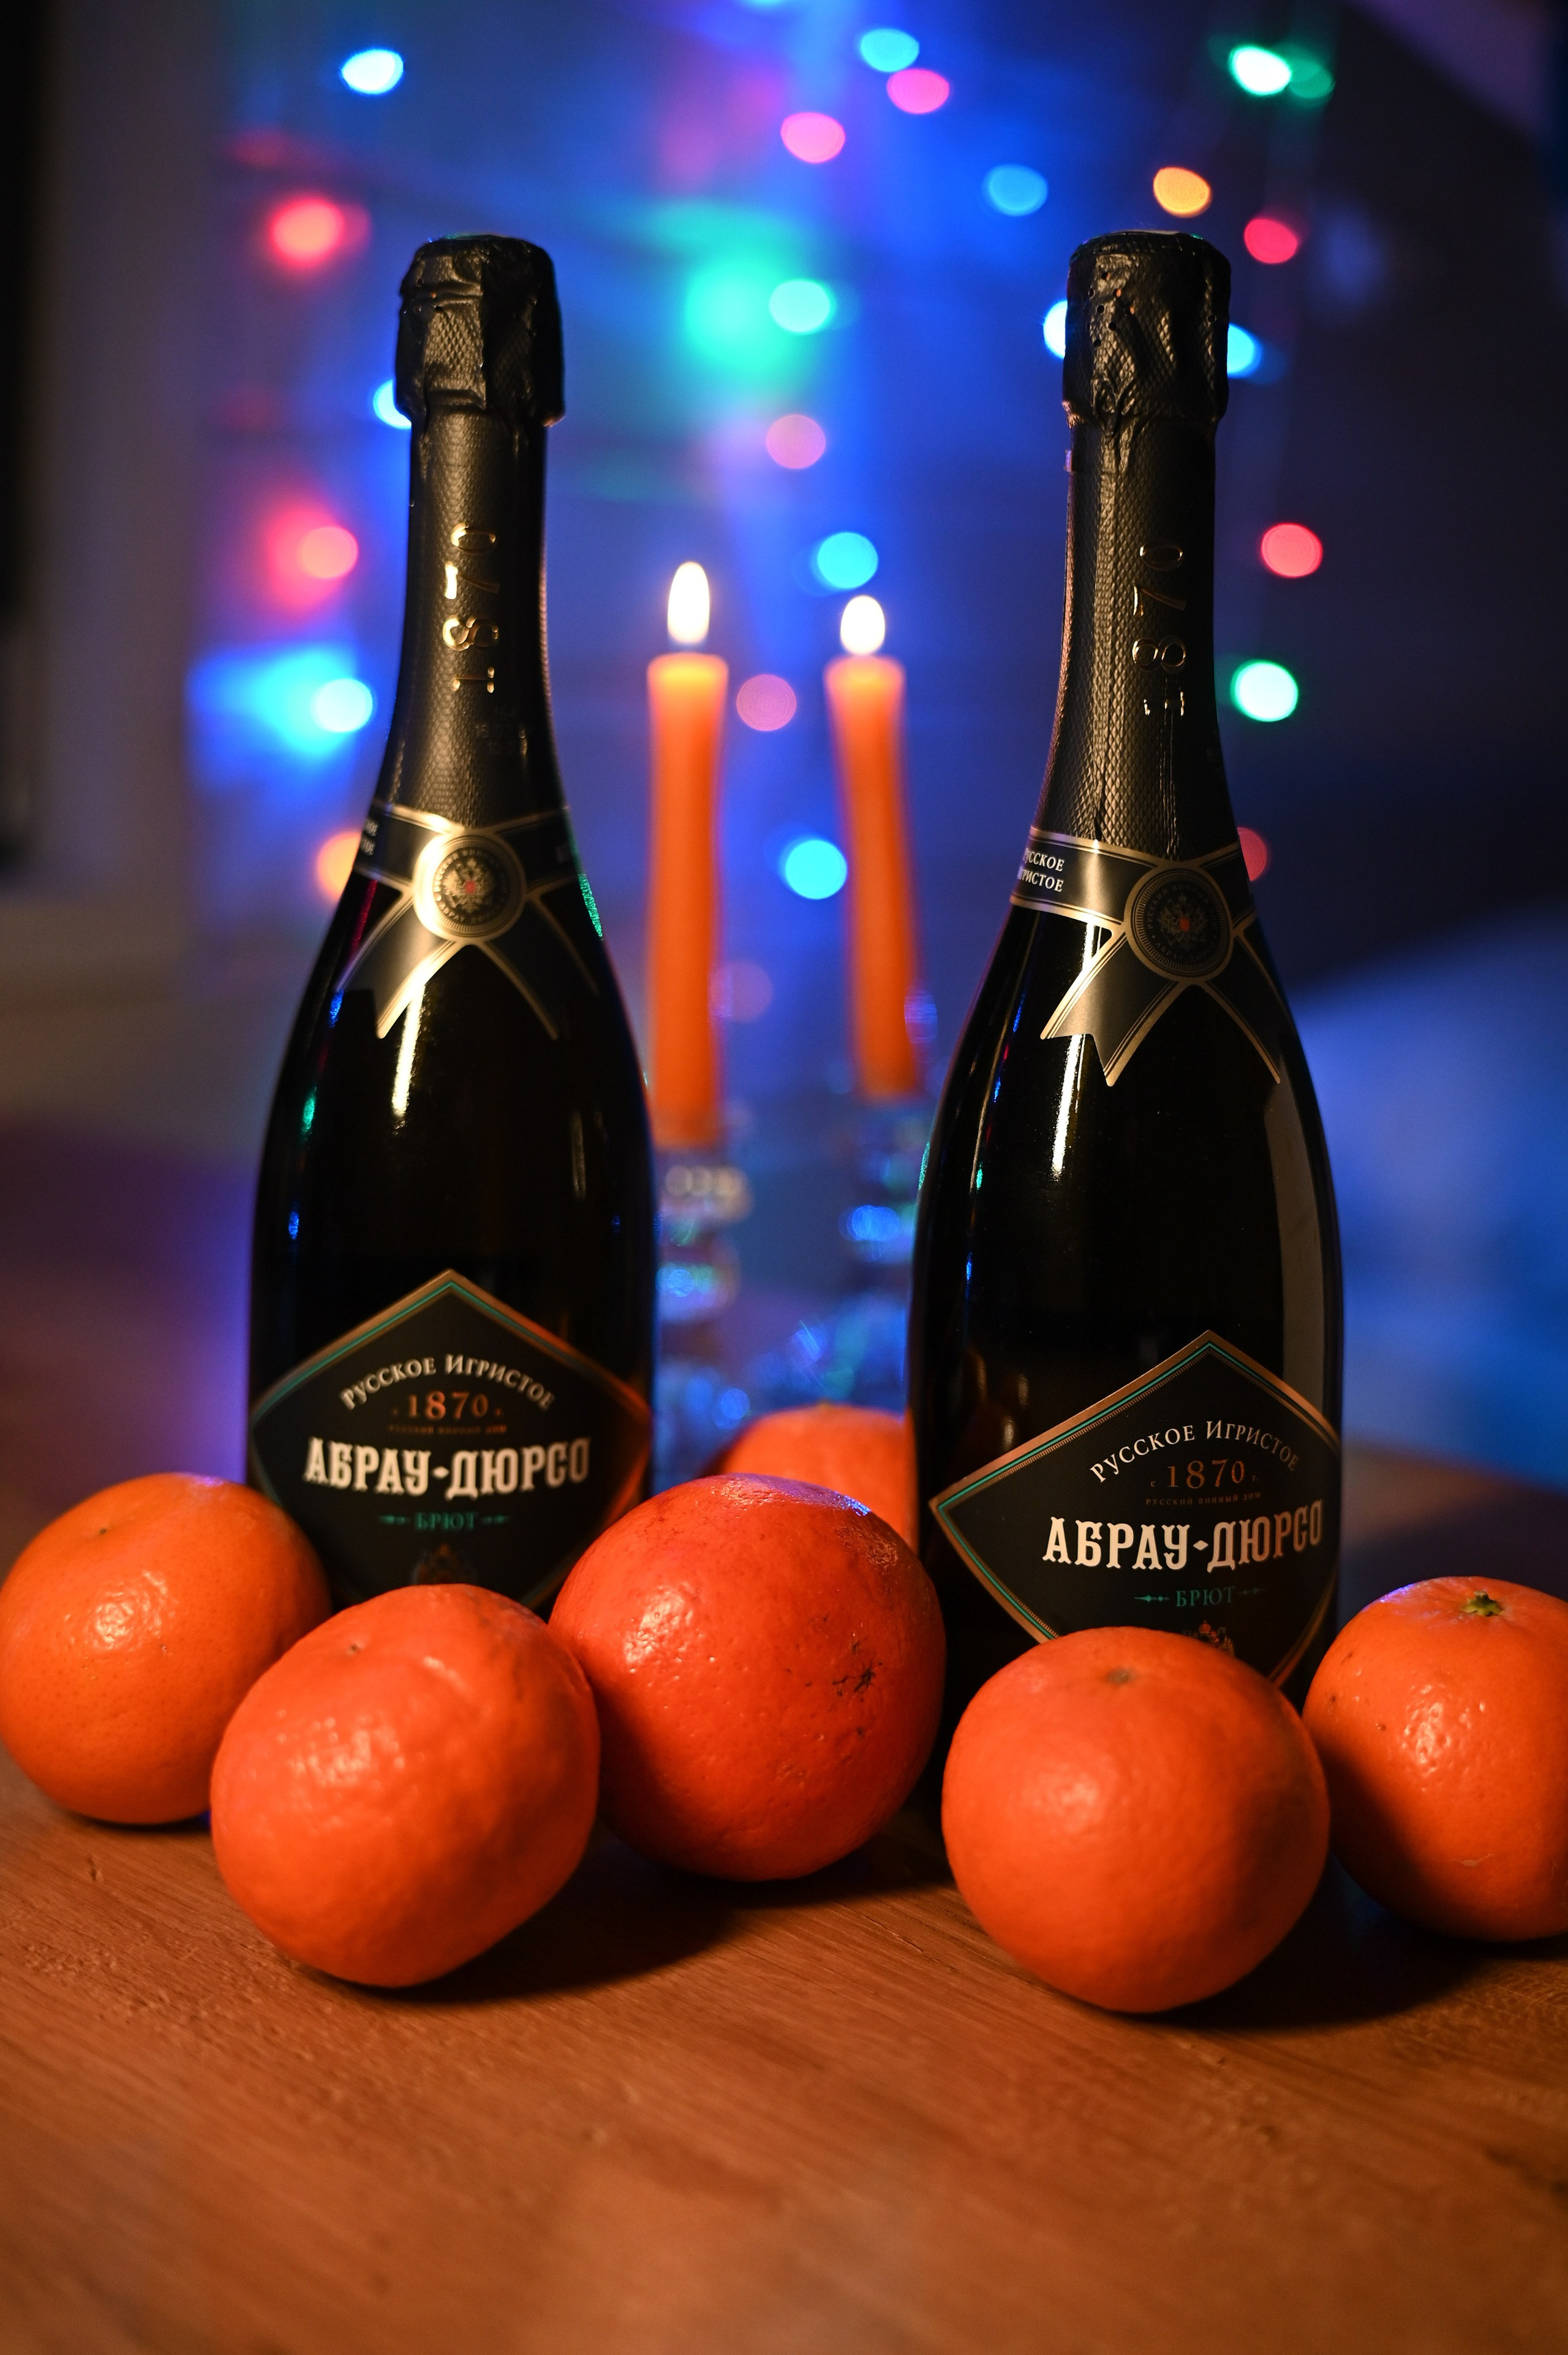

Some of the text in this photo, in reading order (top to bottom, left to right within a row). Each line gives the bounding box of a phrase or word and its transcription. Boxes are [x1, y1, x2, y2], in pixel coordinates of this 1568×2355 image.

[1133, 540, 1187, 717] 1870
[339, 1354, 555, 1410] РУССКОЕ ИГРИСТОЕ
[408, 1390, 489, 1420] 1870
[304, 1437, 590, 1502] АБРАУ-ДЮРСО
[1089, 1419, 1300, 1483] РУССКОЕ ИГРИСТОЕ
[1167, 1459, 1245, 1489] 1870
[1145, 1496, 1193, 1505] РУССКИЙ
[1198, 1493, 1238, 1505] ВИННЫЙ
[415, 1511, 478, 1531] БРЮТ
[1042, 1499, 1324, 1573] АБРАУ-ДЮРСО
[1175, 1586, 1235, 1607] БРЮТ
